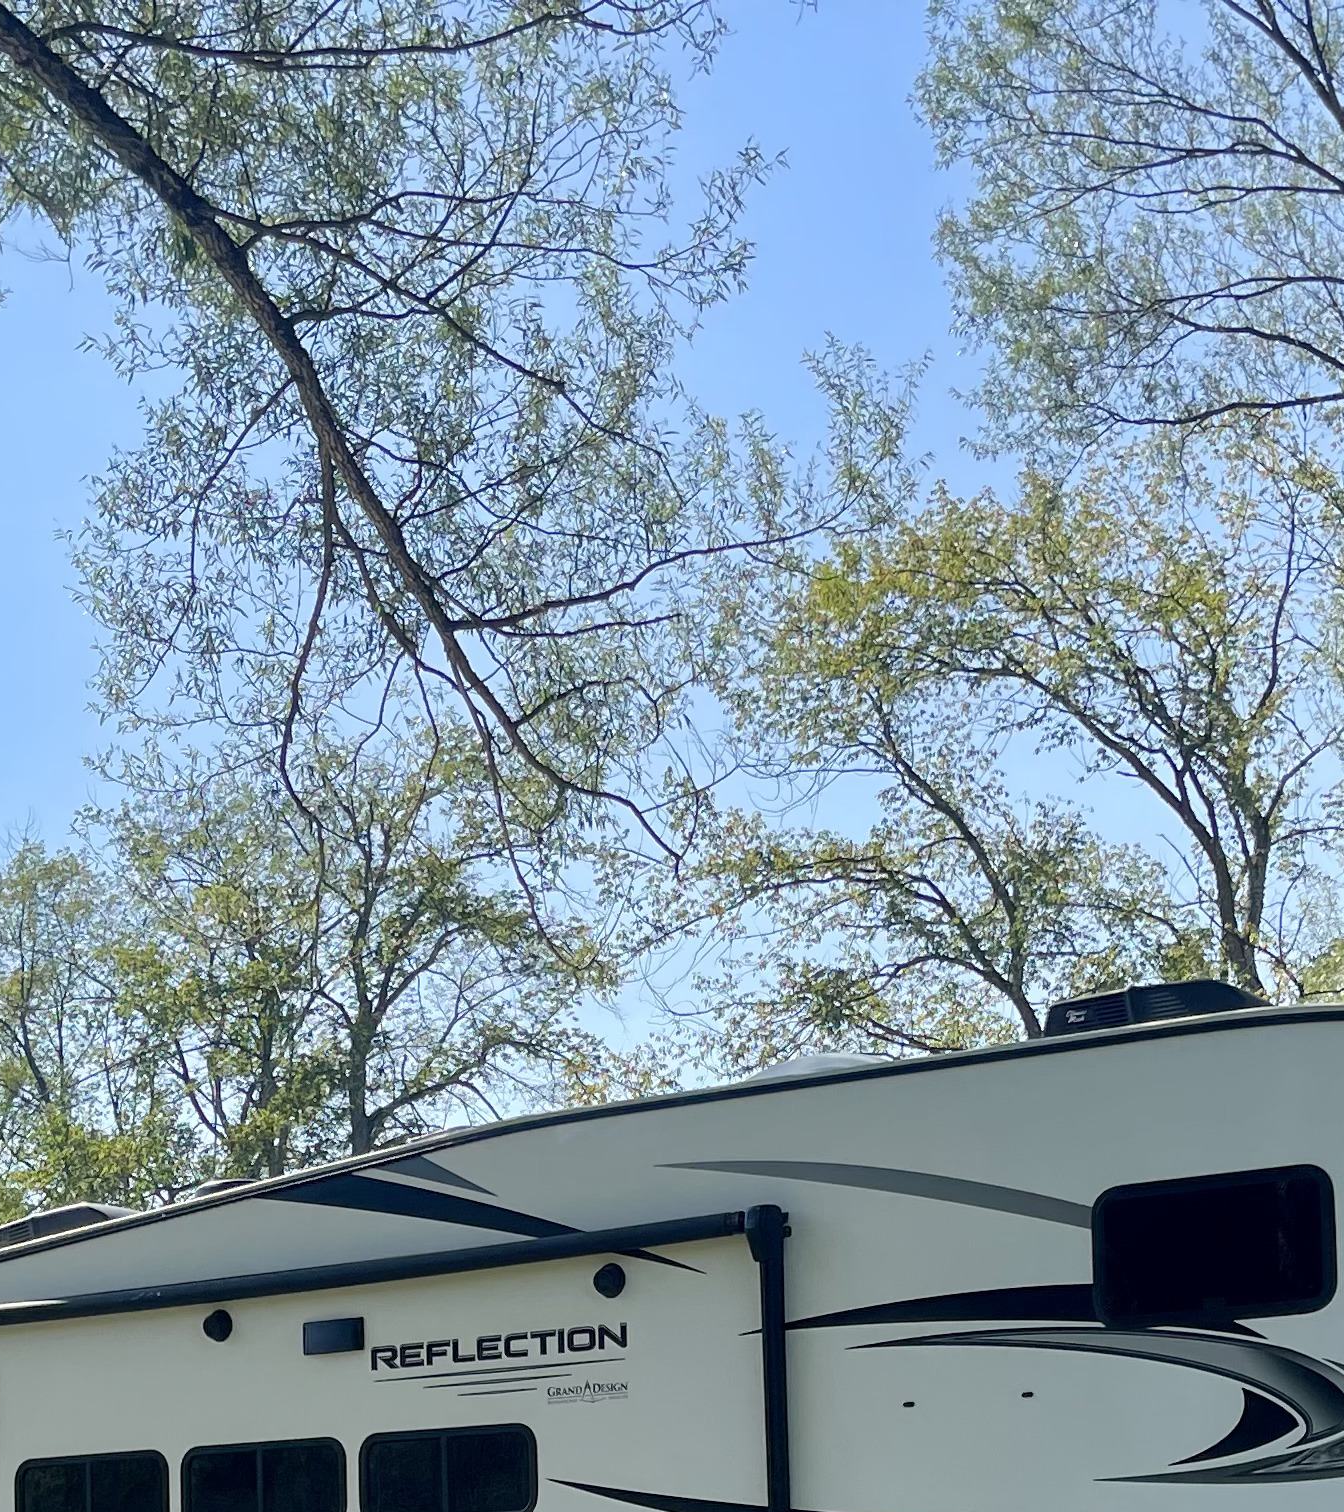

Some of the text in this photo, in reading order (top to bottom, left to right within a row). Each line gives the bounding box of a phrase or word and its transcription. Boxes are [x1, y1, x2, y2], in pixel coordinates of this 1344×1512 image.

[370, 1322, 628, 1371] REFLECTION
[547, 1381, 629, 1397] GRAND DESIGN
